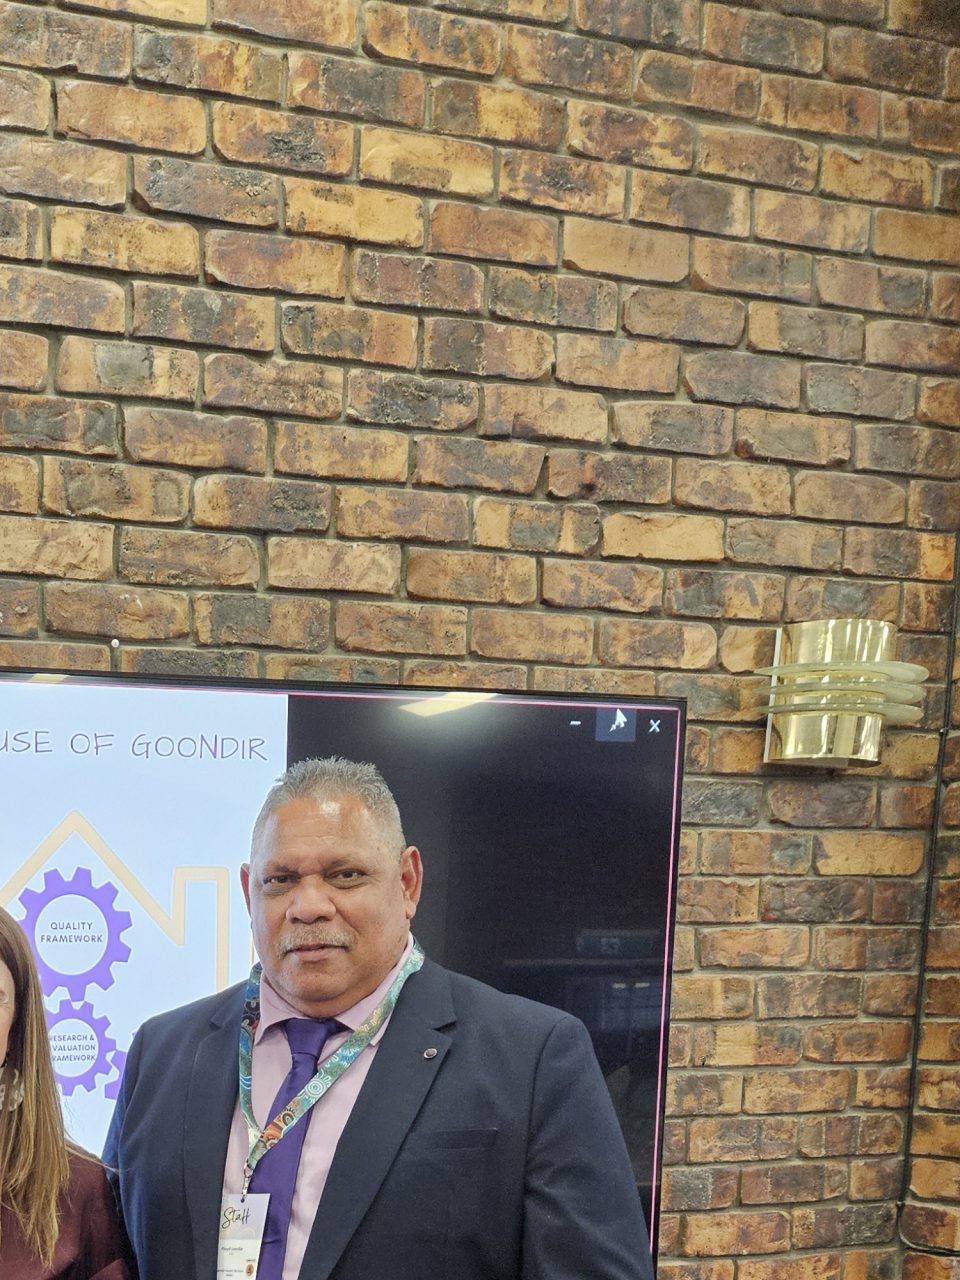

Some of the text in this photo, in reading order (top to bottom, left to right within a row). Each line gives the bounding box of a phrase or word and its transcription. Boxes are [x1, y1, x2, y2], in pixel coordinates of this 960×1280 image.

[69, 732, 115, 756] OF
[131, 733, 268, 761] GOONDIR
[50, 921, 93, 931] QUALITY
[40, 934, 103, 943] FRAMEWORK
[52, 1054, 96, 1062] RAMEWORK
[221, 1206, 251, 1229] Staff
